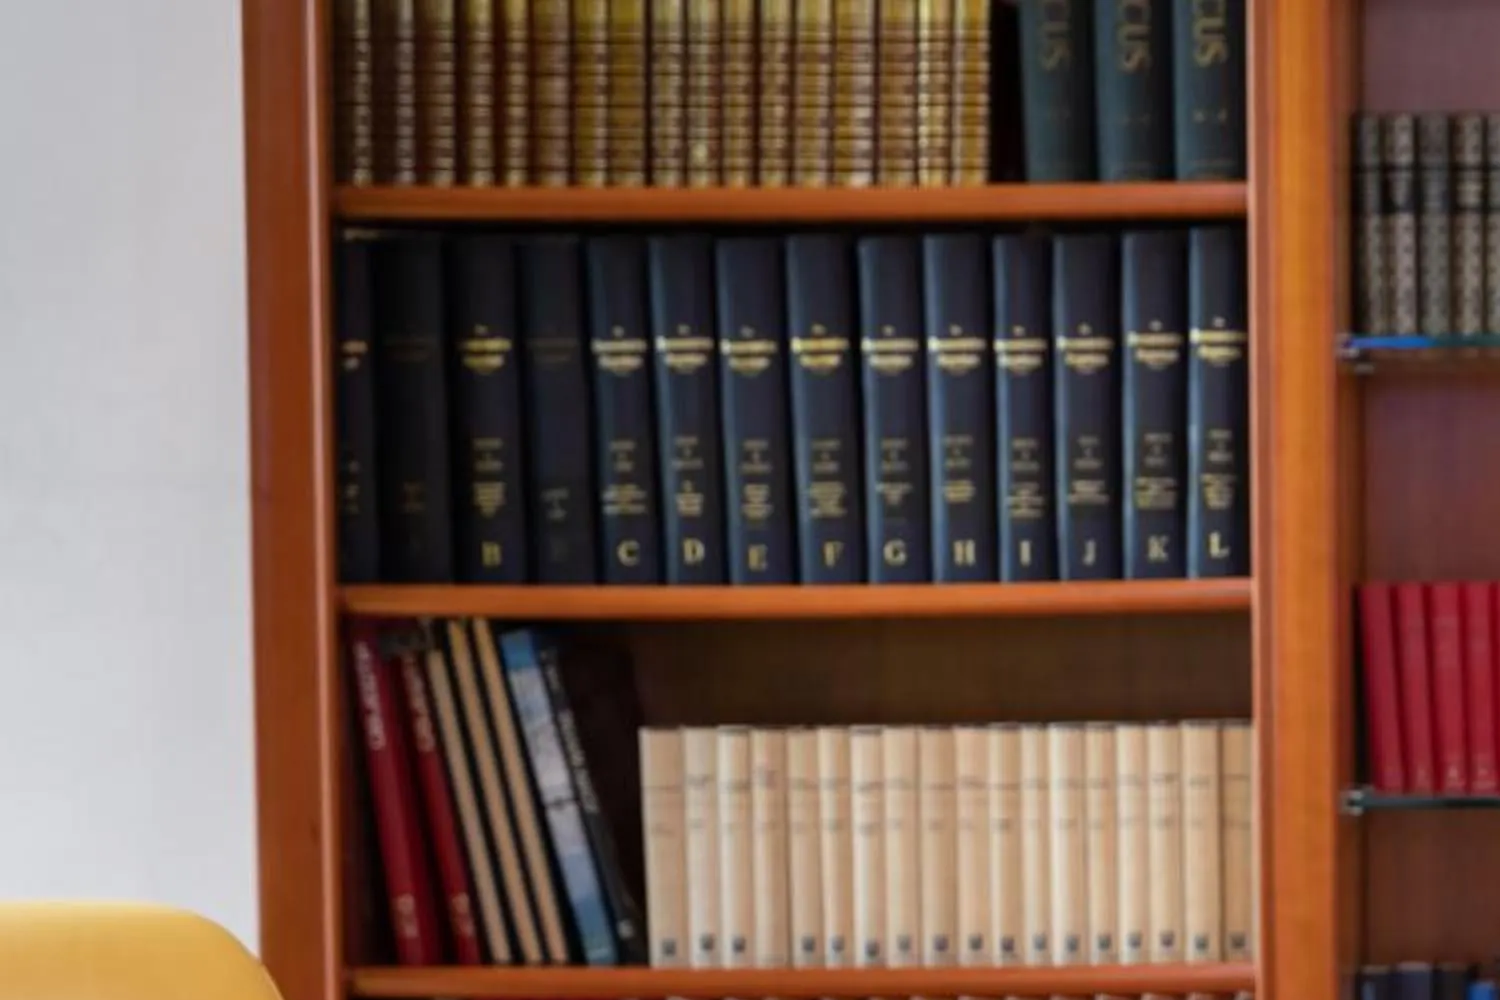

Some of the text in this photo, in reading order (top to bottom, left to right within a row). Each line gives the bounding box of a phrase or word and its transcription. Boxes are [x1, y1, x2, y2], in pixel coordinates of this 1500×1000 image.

[617, 541, 639, 566] C
[684, 538, 705, 564] D
[748, 544, 768, 570] E
[823, 542, 844, 567] F
[883, 540, 907, 566] G
[953, 540, 976, 566] H
[1019, 540, 1032, 566] I
[1082, 540, 1096, 566] J
[1147, 536, 1169, 561] K
[1209, 531, 1229, 558] L
